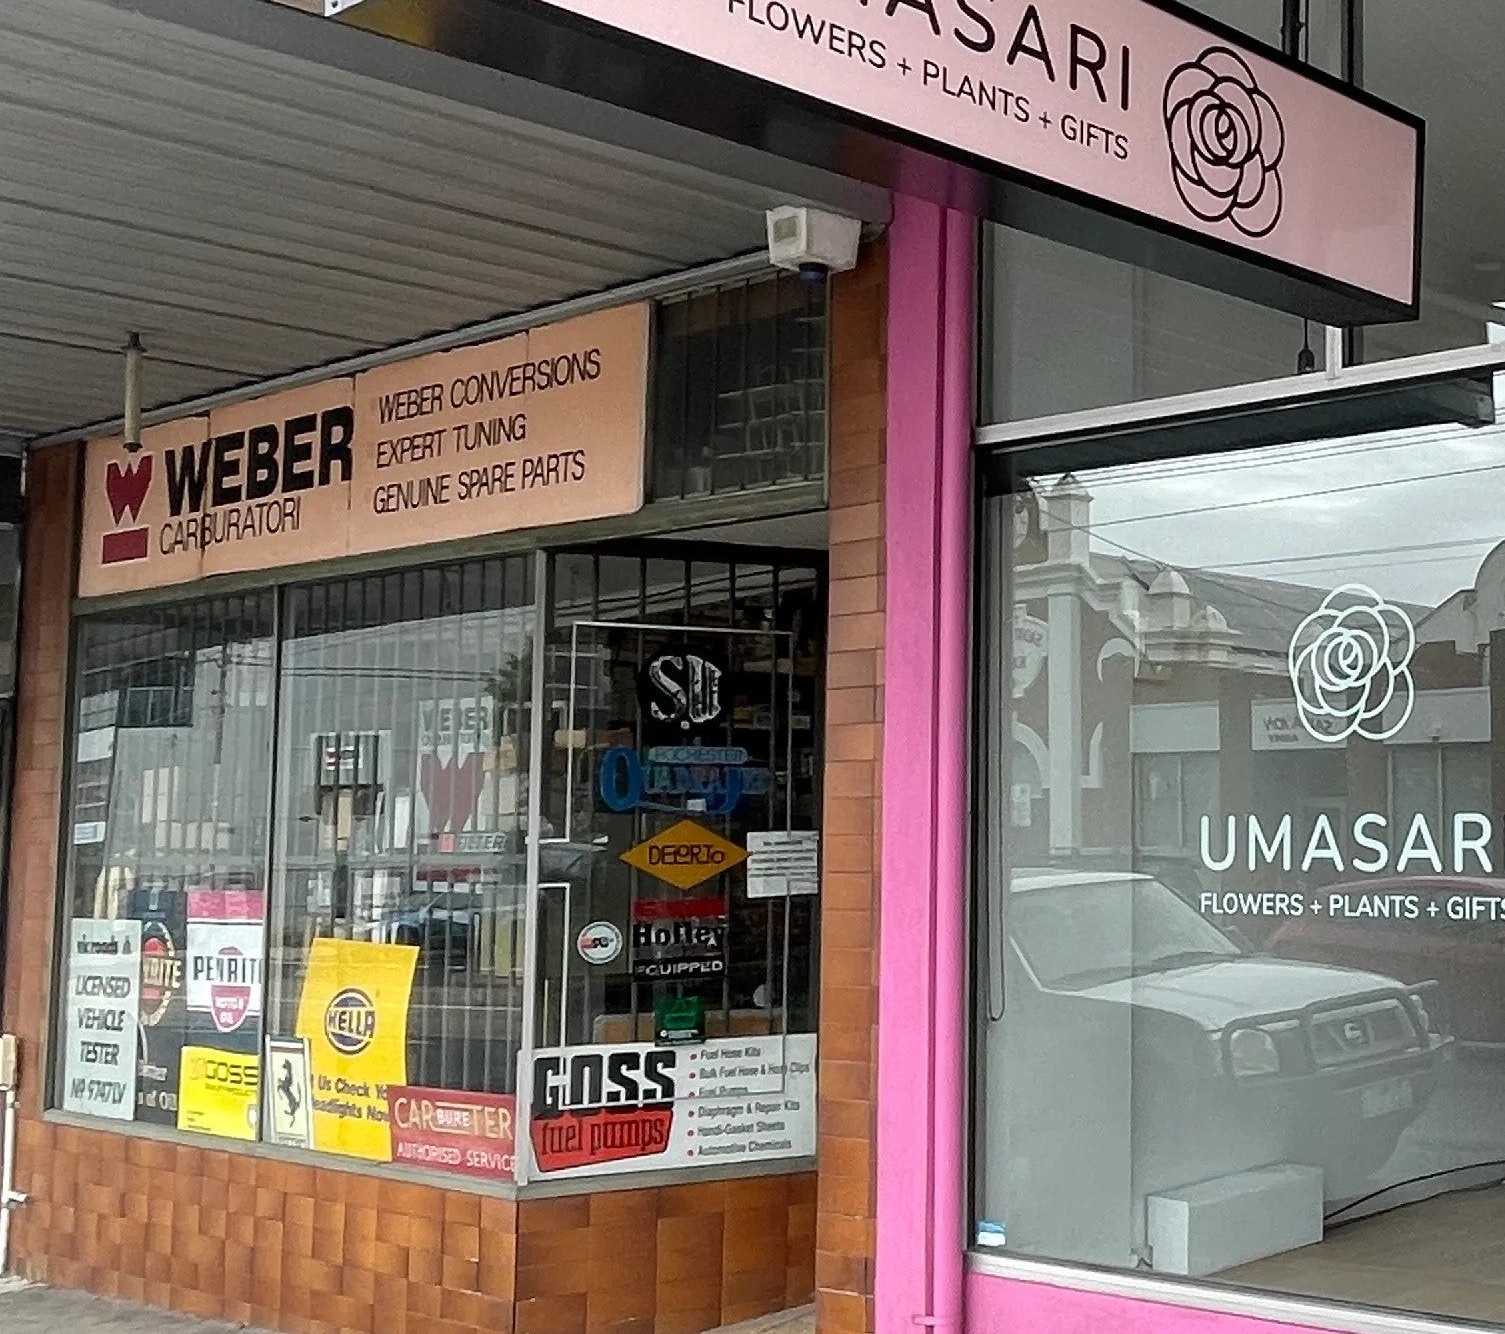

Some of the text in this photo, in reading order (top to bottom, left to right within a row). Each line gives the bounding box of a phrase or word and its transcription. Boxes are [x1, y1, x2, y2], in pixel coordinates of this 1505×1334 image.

[897, 56, 914, 78] +
[922, 58, 1030, 123] PLANTS
[1038, 110, 1053, 131] +
[1060, 112, 1130, 162] GIFTS
[377, 347, 602, 425] WEBER CONVERSIONS
[164, 404, 355, 518] WEBER
[375, 413, 527, 469] EXPERT TUNING
[373, 449, 586, 514] GENUINE SPARE PARTS
[159, 495, 301, 556] CARBURATORI
[1200, 892, 1305, 917] FLOWERS
[1310, 900, 1323, 914] +
[1329, 894, 1420, 919] PLANTS
[1426, 901, 1439, 916] +
[75, 974, 132, 999] LICENSED
[77, 1007, 126, 1033] VEHICLE
[328, 1009, 376, 1039] HELLA
[79, 1040, 121, 1066] TESTER
[700, 1049, 720, 1061] Fuel
[533, 1049, 677, 1114] GOSS
[541, 1114, 666, 1157] fuel pumps
